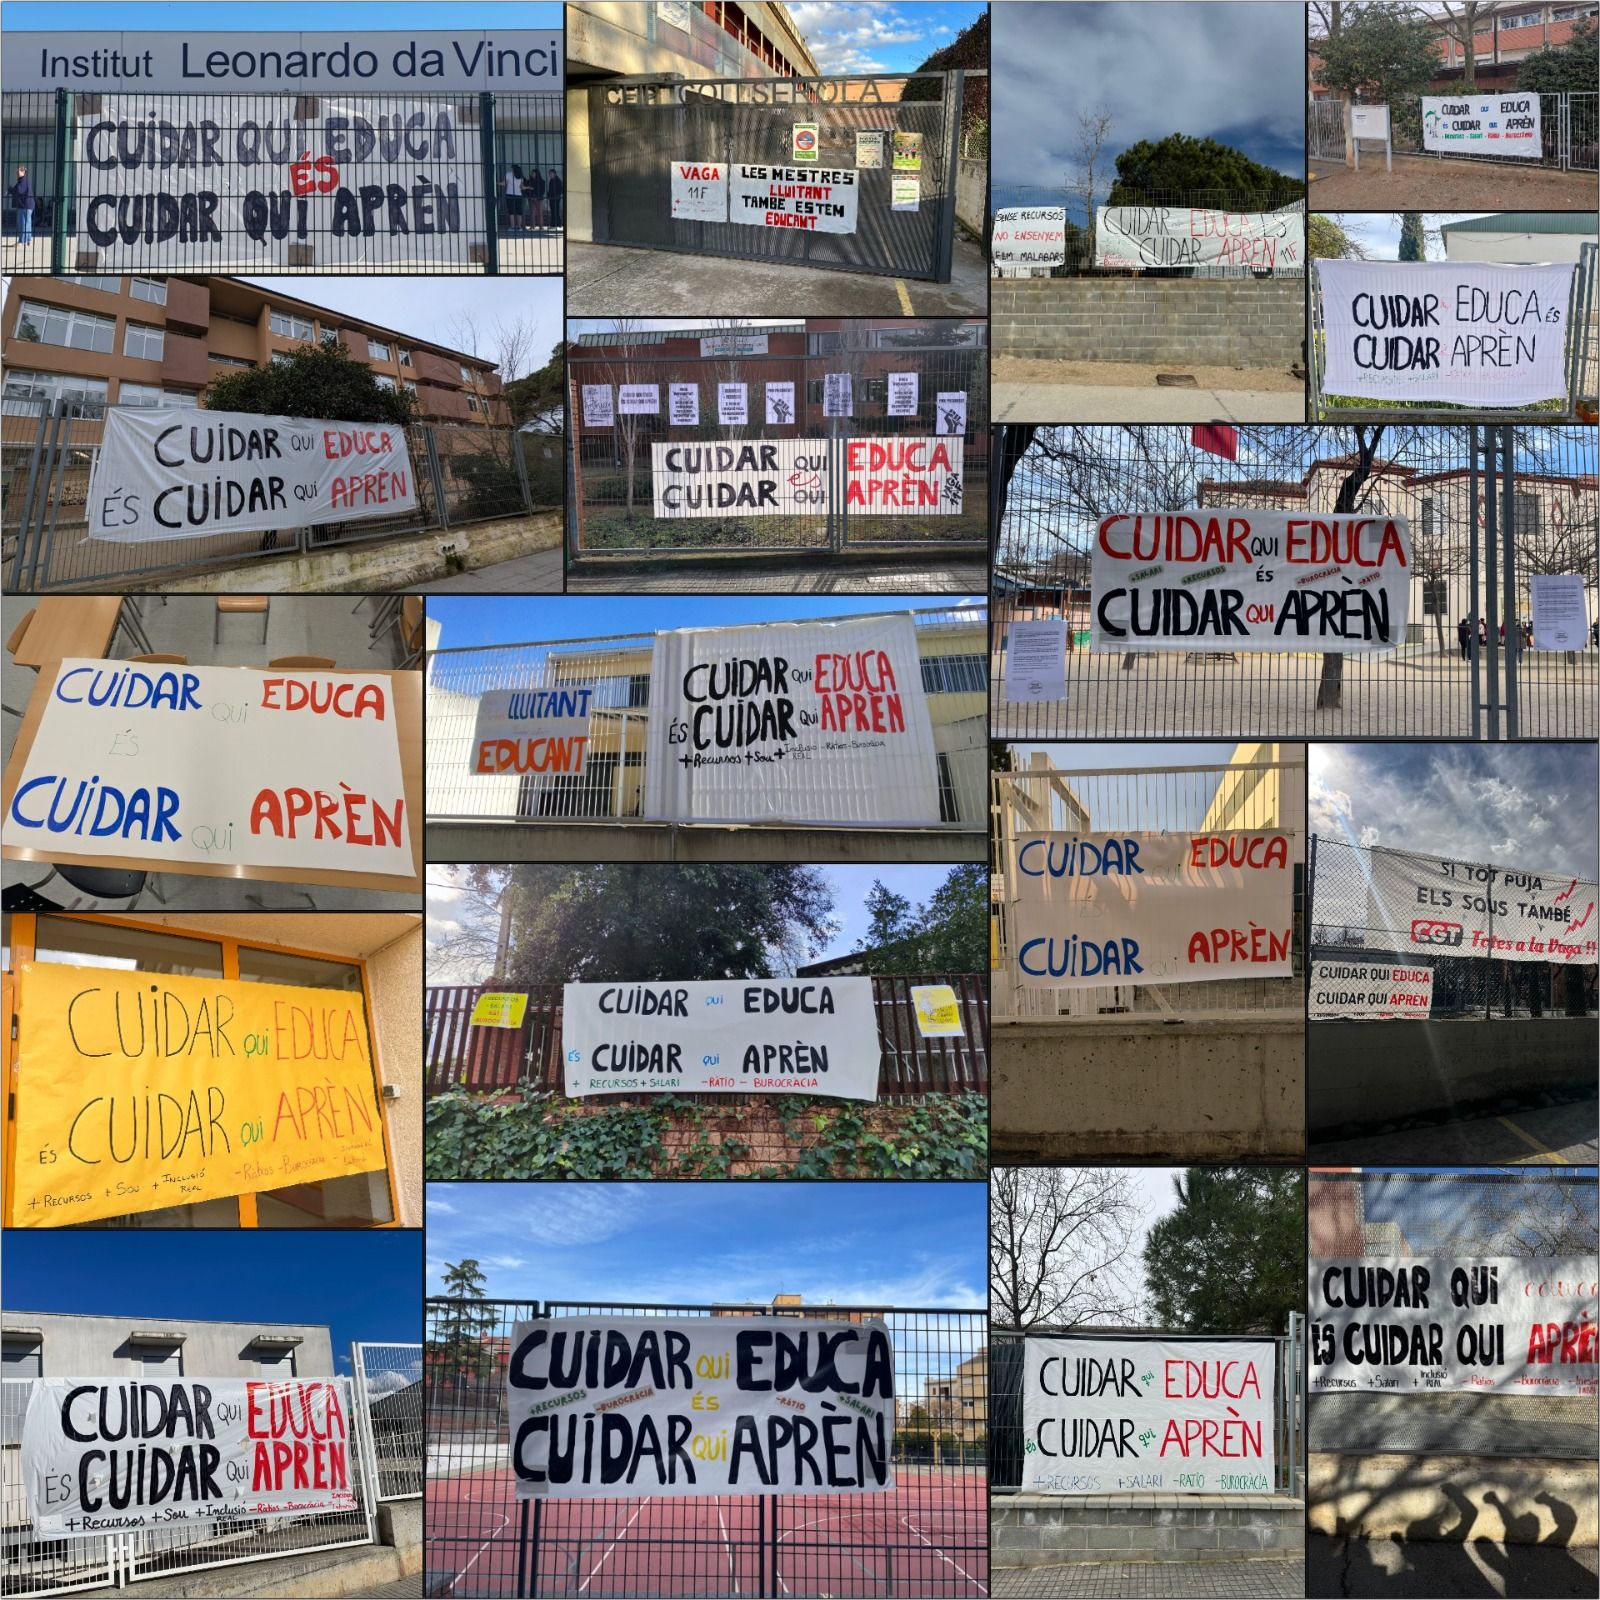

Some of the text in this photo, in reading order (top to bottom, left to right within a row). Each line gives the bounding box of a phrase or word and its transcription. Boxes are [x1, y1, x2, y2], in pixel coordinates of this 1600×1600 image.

[42, 41, 557, 78] Institut Leonardo da Vinci
[1501, 101, 1530, 113] EDUCA
[1506, 115, 1535, 129] APRÈN
[325, 111, 456, 164] EDUCA
[290, 152, 340, 195] ÉS
[680, 166, 719, 180] VAGA
[742, 167, 854, 185] LES MESTRES
[332, 175, 461, 237] APRÈN
[688, 187, 708, 199] 11F
[770, 184, 832, 200] LLUITANT
[796, 201, 844, 217] ESTEM
[766, 212, 817, 229] EDUCANT
[1021, 210, 1063, 220] RECURSOS
[1104, 207, 1170, 236] CUIDAR
[995, 230, 1063, 242] NO ENSENYEM
[1140, 238, 1201, 266] CUIDAR
[1021, 252, 1064, 263] MALABARS
[1352, 293, 1440, 330] CUIDAR
[1456, 285, 1541, 324] EDUCA
[1353, 329, 1535, 370] CUIDAR APRÈN
[324, 430, 393, 460] EDUCA
[665, 442, 952, 473] CUIDAR QUI EDUCA
[102, 491, 140, 528] ÉS
[332, 467, 406, 509] APRÈN
[662, 474, 939, 509] CUIDAR QUI APRÈN
[941, 473, 959, 499] VAGA
[1099, 514, 1407, 567] CUIDAR QUI EDUCA
[1257, 565, 1273, 581] ÉS
[1097, 576, 1389, 642] CUIDAR QUI APRÈN
[814, 649, 896, 693] EDUCA
[261, 678, 385, 721] EDUCA
[508, 691, 592, 720] LLUITANT
[669, 718, 688, 744] ÉS
[821, 691, 905, 734] APRÈN
[109, 729, 138, 756] ÉS
[477, 736, 588, 773] EDUCANT
[250, 782, 403, 848] APRÈN
[1191, 836, 1288, 869] EDUCA
[1440, 862, 1542, 892] SI TOT PUJA
[1417, 887, 1570, 923] ELS SOUS TAMBÉ
[1188, 921, 1290, 963] APRÈN
[1414, 922, 1461, 945] CGT
[1516, 940, 1526, 951] a
[1529, 937, 1545, 954] la
[1548, 938, 1581, 960] Vaga
[1320, 967, 1430, 983] CUIDAR QUI EDUCA
[744, 986, 834, 1014] EDUCA
[1317, 991, 1428, 1006] CUIDAR QUI APRÈN
[275, 1000, 364, 1061] EDUCA
[742, 1040, 829, 1074] APRÈN
[590, 1079, 637, 1088] RECURSOS
[650, 1078, 680, 1087] SALARI
[272, 1077, 373, 1142] APRÈN
[1322, 1265, 1430, 1308] CUIDAR
[1343, 1322, 1443, 1366] CUIDAR
[1457, 1324, 1504, 1366] QUI
[1527, 1311, 1599, 1364] APRÈ
[736, 1330, 893, 1398] EDUCA
[1039, 1357, 1142, 1397] CUIDAR
[1165, 1360, 1261, 1399] EDUCA
[246, 1382, 345, 1441] EDUCA
[530, 1390, 587, 1415] +RECURSOS
[728, 1402, 887, 1488] APRÈN
[1037, 1419, 1139, 1458] CUIDAR
[1160, 1407, 1262, 1457] APRÈN
[45, 1468, 72, 1504] ÉS
[252, 1439, 346, 1492] APRÈN
